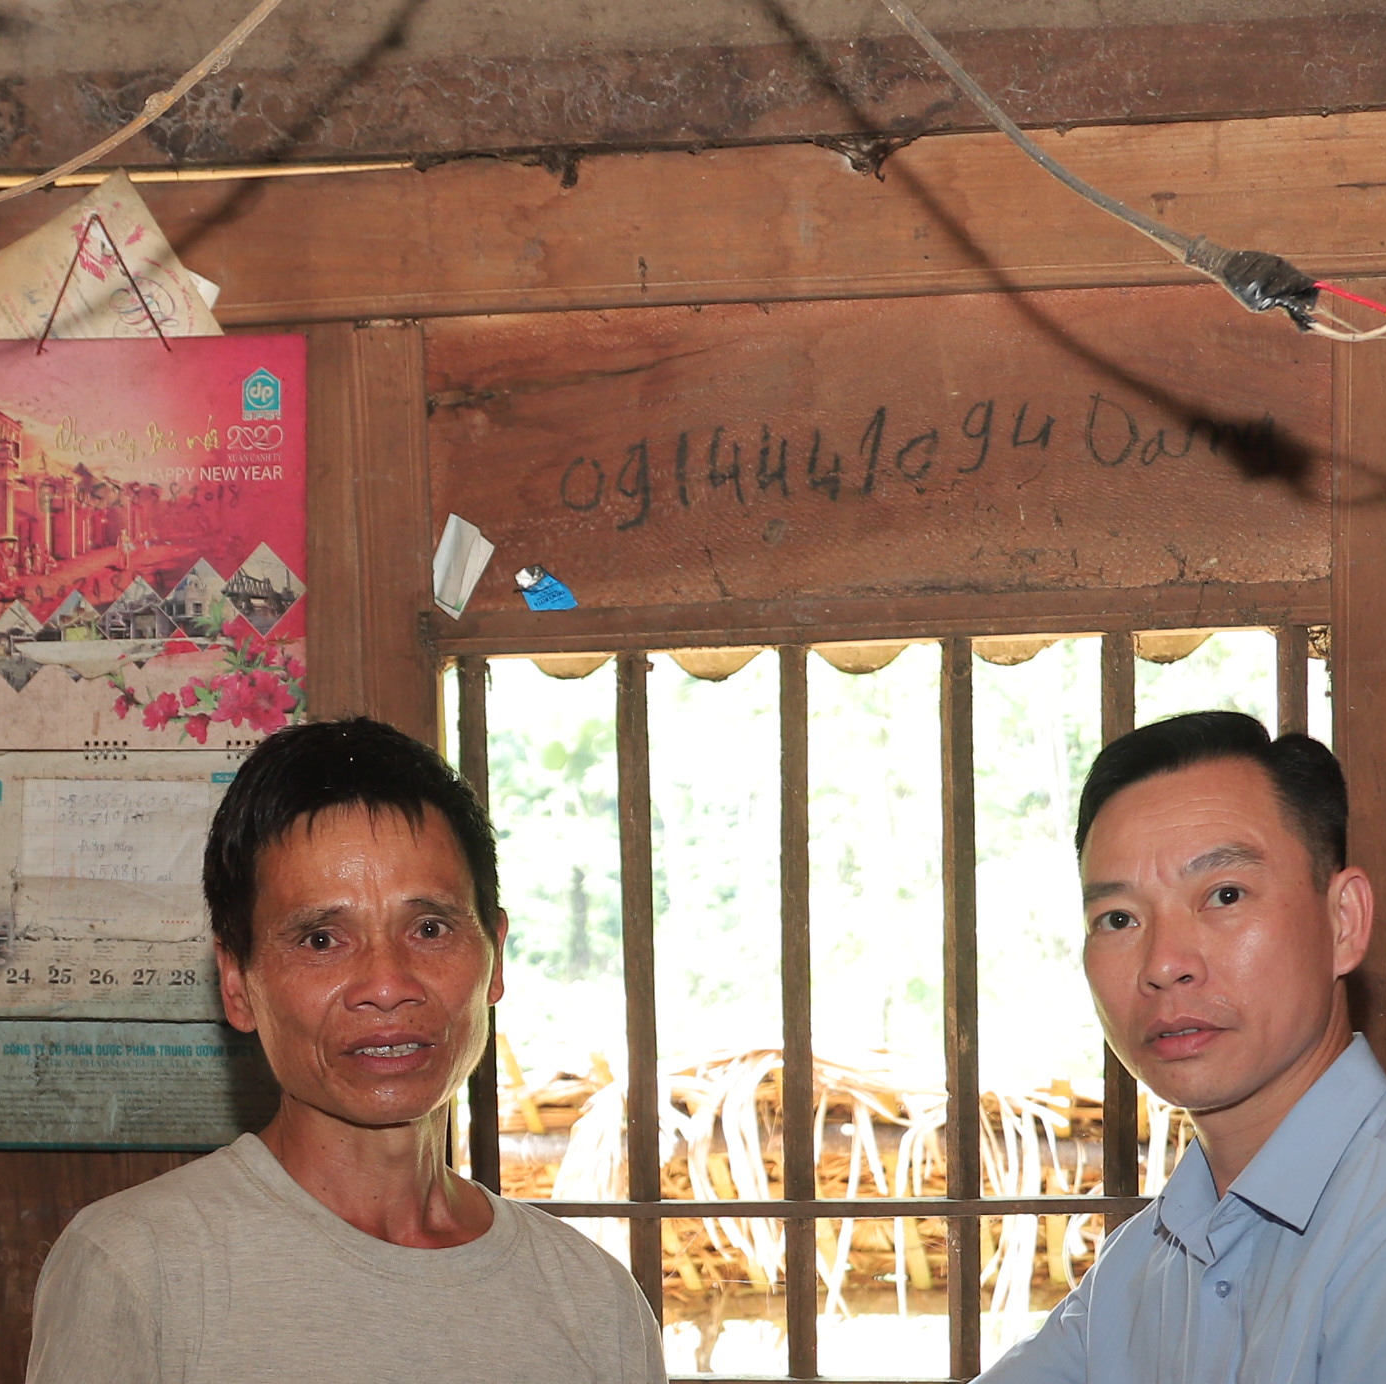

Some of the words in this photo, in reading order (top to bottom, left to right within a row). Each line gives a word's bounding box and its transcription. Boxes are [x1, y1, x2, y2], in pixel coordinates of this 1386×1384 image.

[226, 424, 284, 451] 2020
[141, 467, 195, 481] HAPPY
[199, 466, 238, 481] NEW
[240, 465, 283, 480] YEAR
[6, 968, 30, 984] 24
[48, 966, 72, 984] 25
[89, 968, 114, 985] 26
[132, 968, 157, 985] 27
[168, 968, 196, 985] 28
[33, 1043, 45, 1056] TY
[160, 1044, 192, 1057] TRUNG
